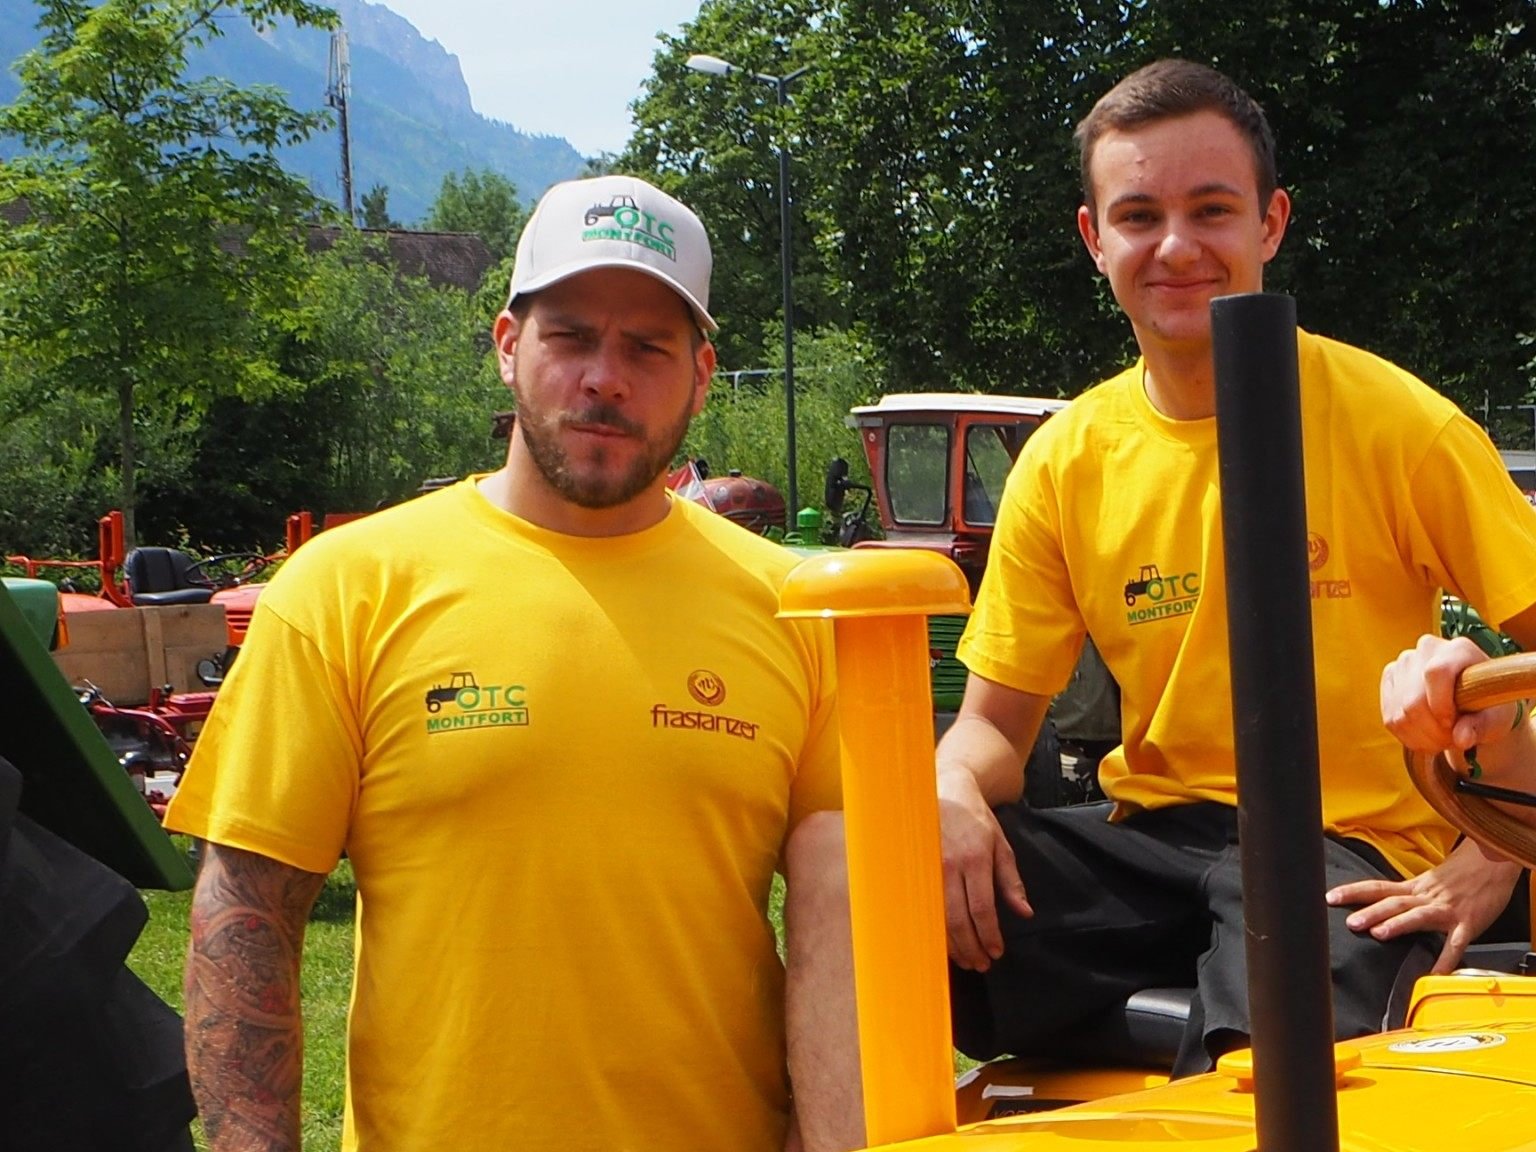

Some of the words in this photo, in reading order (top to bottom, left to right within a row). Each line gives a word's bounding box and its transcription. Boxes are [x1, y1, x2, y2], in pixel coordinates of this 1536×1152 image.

[1146, 572, 1200, 601] OTC
[456, 685, 526, 710] OTC
[426, 711, 525, 731] MONTFORT
[650, 704, 760, 741] frastanzer
